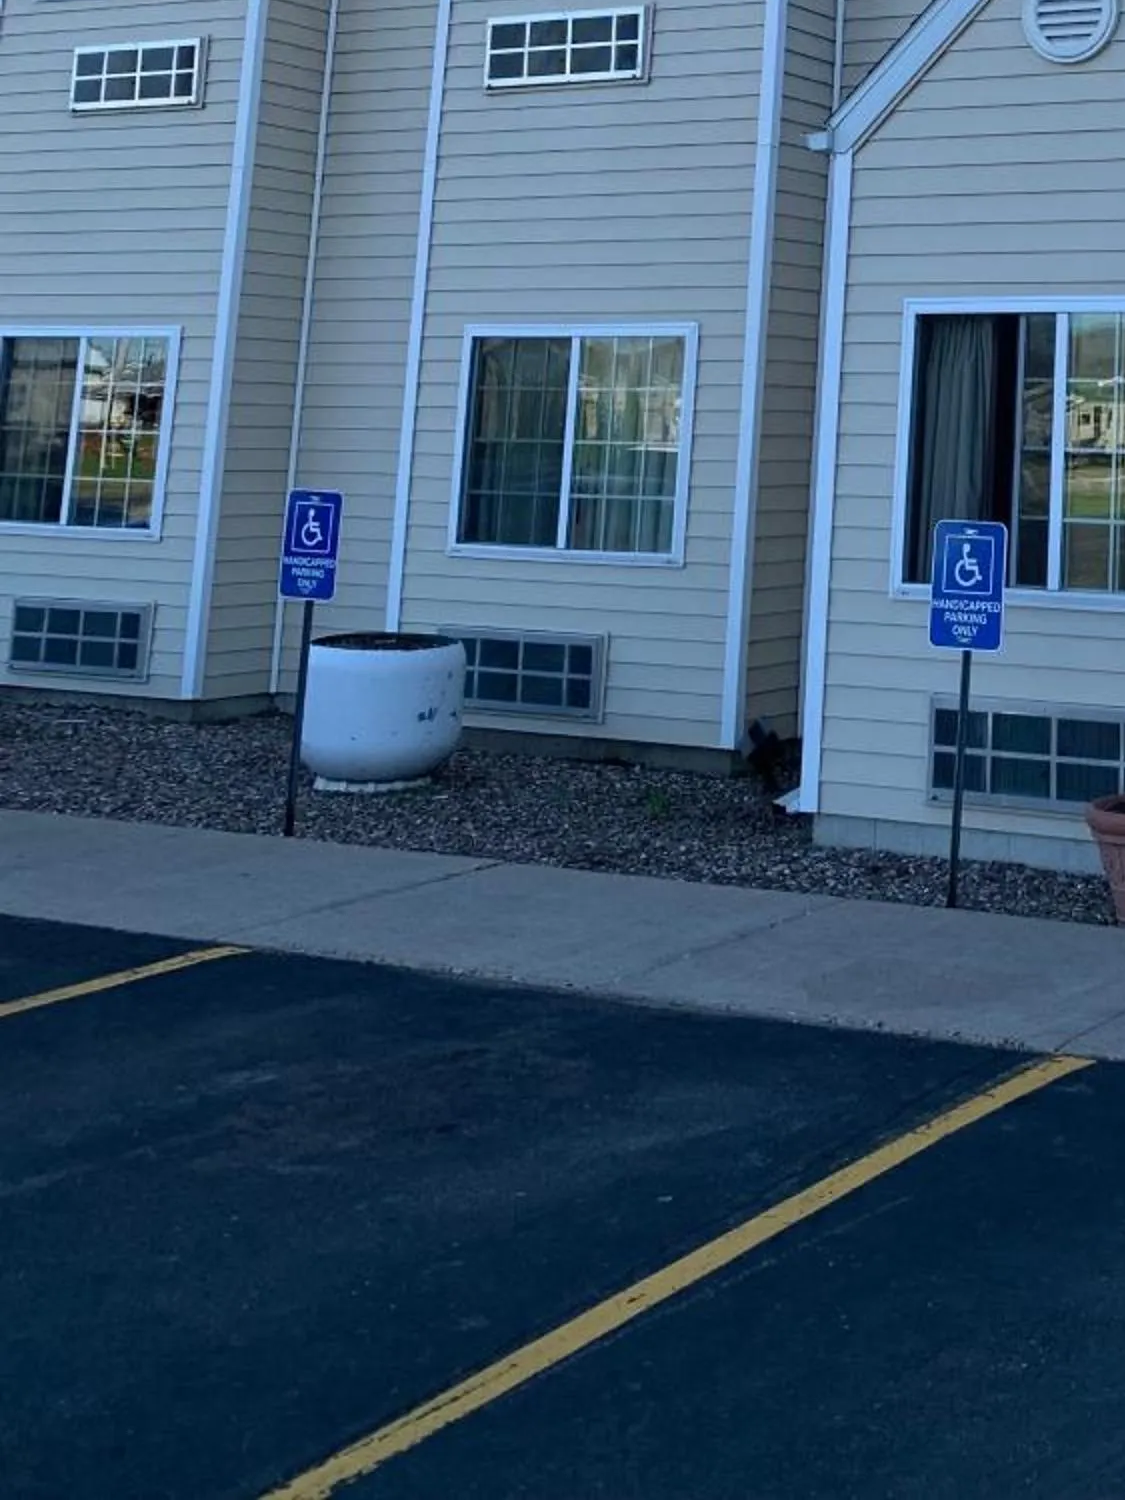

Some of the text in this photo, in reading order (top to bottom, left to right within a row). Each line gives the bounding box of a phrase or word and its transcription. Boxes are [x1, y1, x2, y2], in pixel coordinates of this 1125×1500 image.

[291, 567, 325, 579] PARKING
[297, 578, 317, 588] ONLY
[933, 599, 1001, 613] HANDICAPPED
[944, 611, 988, 625] PARKING
[951, 625, 979, 637] ONLY
